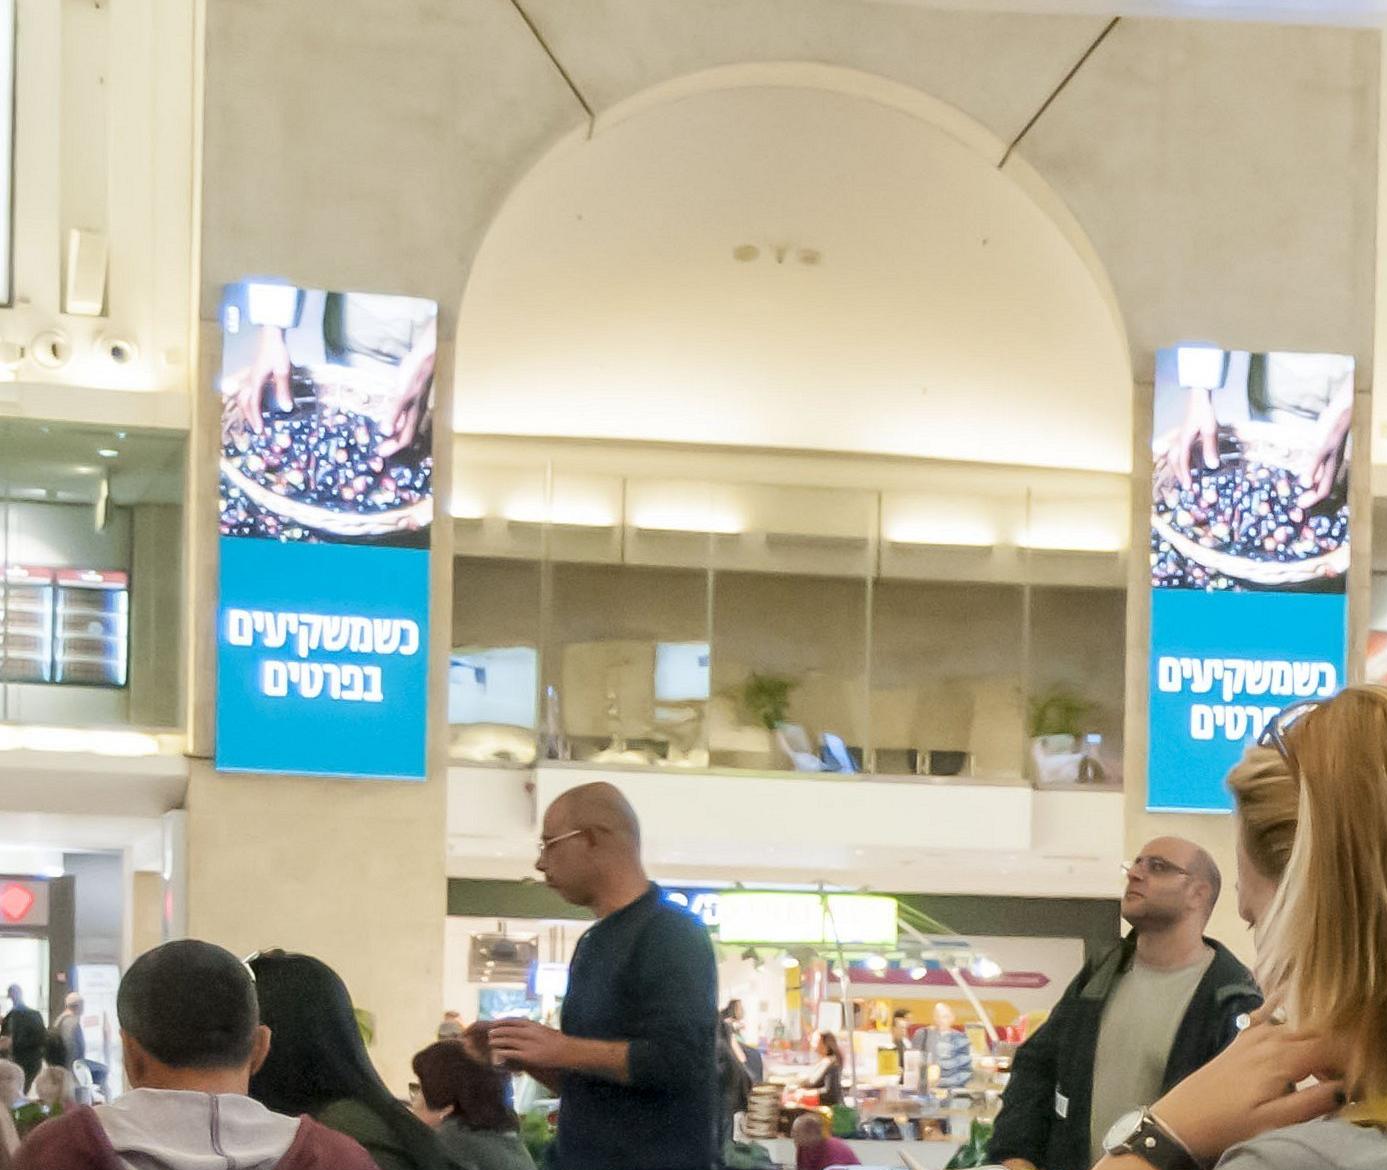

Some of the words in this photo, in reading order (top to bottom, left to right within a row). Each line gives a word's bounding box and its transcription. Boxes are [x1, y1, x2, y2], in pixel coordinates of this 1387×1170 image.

[228, 608, 419, 657] כשמשקיעים
[262, 659, 383, 703] בפרטים
[1157, 656, 1337, 702] כשמשקיעים
[1190, 703, 1281, 741] רטים
